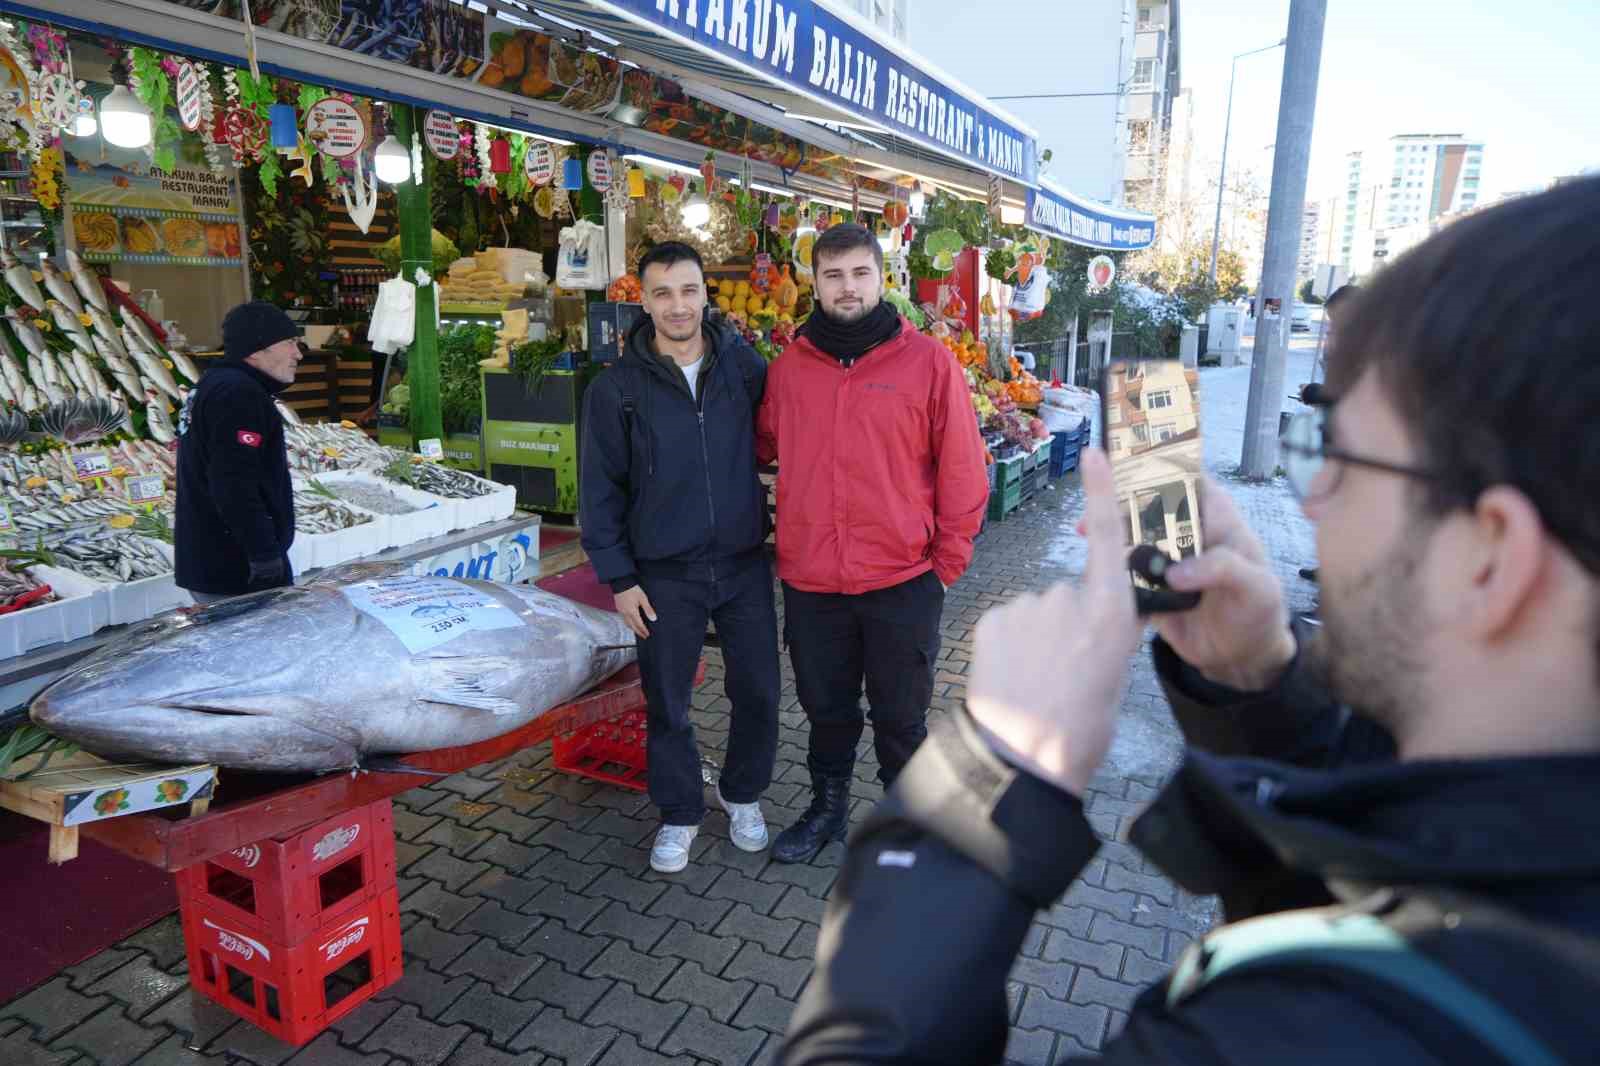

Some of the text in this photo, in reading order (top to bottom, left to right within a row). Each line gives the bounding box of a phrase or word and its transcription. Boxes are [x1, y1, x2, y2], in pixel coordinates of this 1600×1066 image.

[656, 0, 797, 73] AKUM
[886, 67, 974, 155] RESTORANT
[977, 124, 985, 160] &
